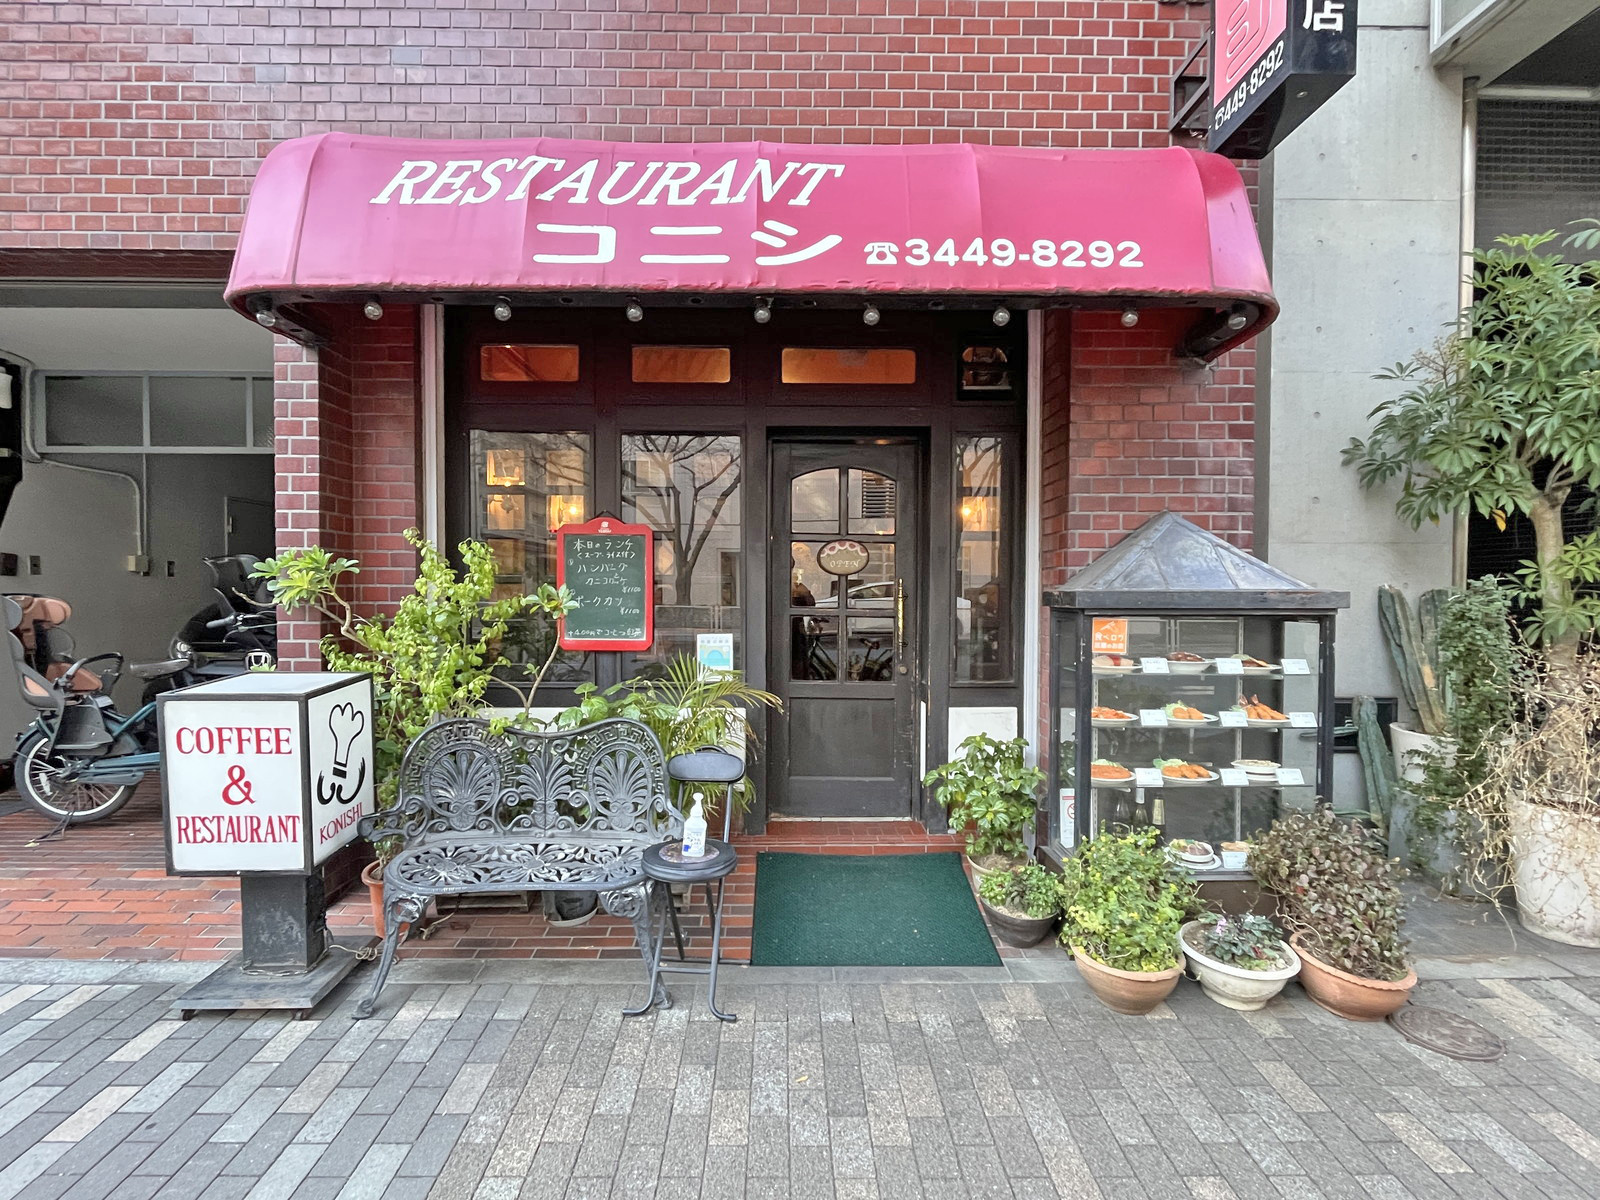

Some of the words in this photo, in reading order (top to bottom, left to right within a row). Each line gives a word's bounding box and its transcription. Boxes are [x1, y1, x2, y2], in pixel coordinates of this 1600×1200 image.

[370, 156, 846, 206] RESTAURANT
[533, 220, 844, 265] コニシ
[905, 237, 1144, 268] 3449-8292
[830, 560, 861, 569] OPEN
[176, 727, 292, 754] COFFEE
[221, 764, 256, 806] &
[176, 815, 300, 844] RESTAURANT
[319, 801, 365, 845] KONISHI
